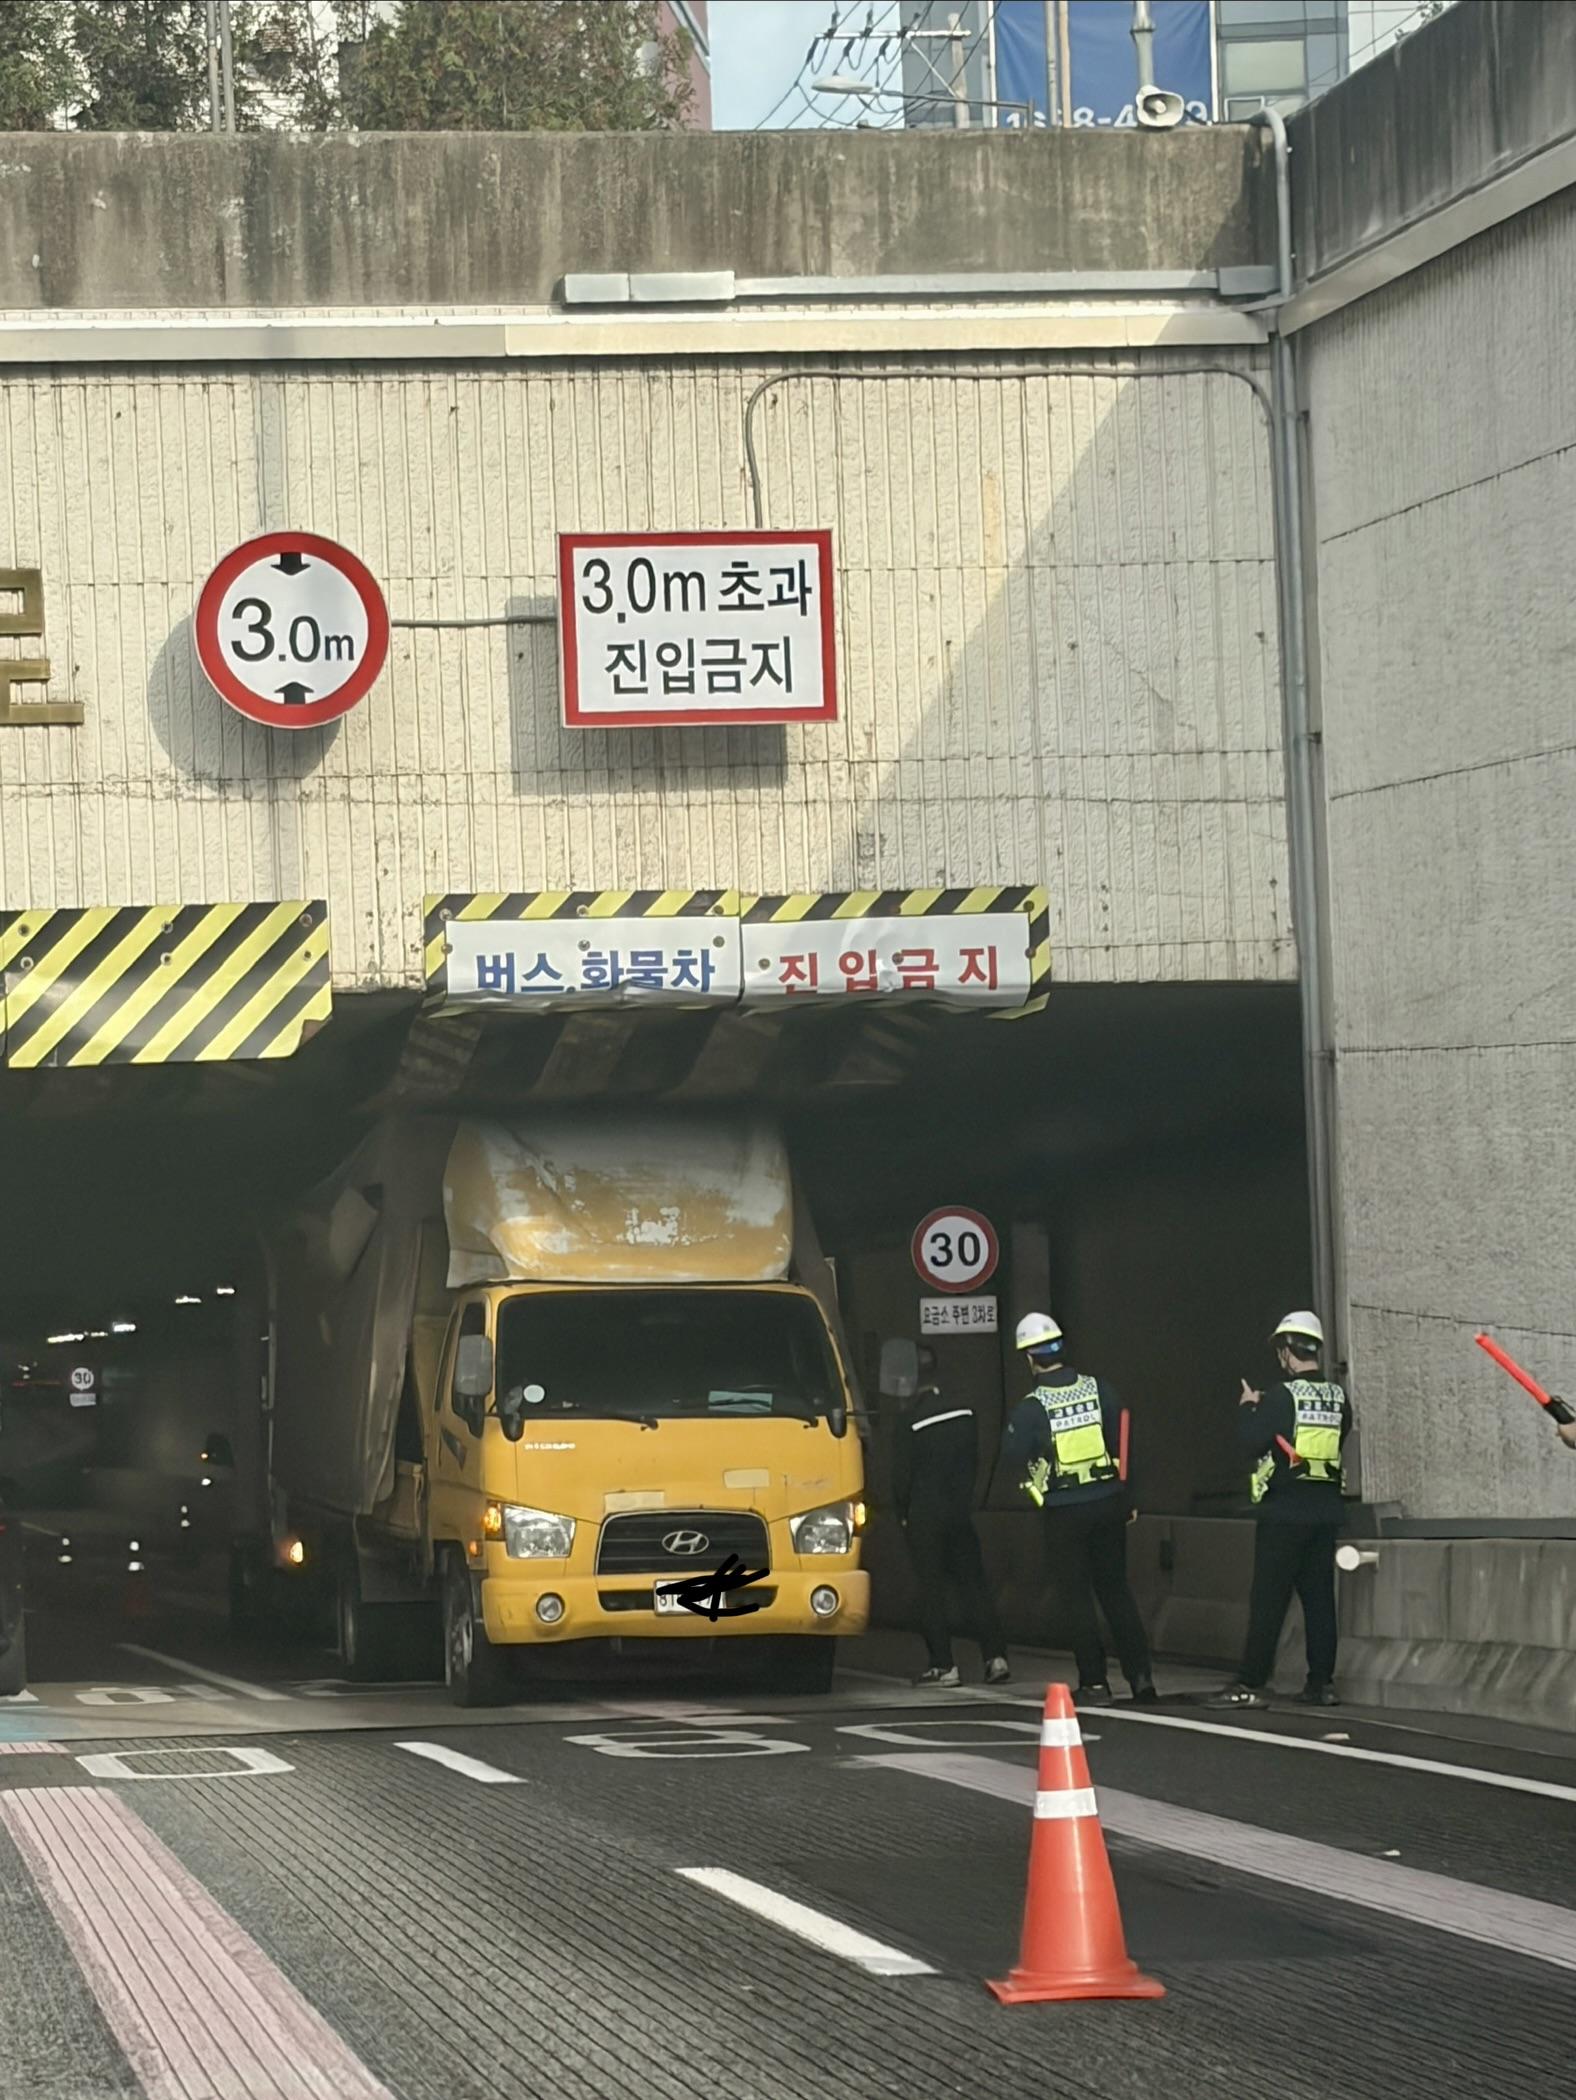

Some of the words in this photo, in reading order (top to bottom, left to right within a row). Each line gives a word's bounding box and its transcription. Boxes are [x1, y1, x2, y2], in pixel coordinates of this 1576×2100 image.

[582, 557, 706, 623] 3.0m
[718, 559, 812, 617] 초과
[231, 597, 355, 663] 3.0m
[604, 636, 792, 695] 진입금지
[930, 1231, 981, 1267] 30
[74, 1372, 91, 1385] 30
